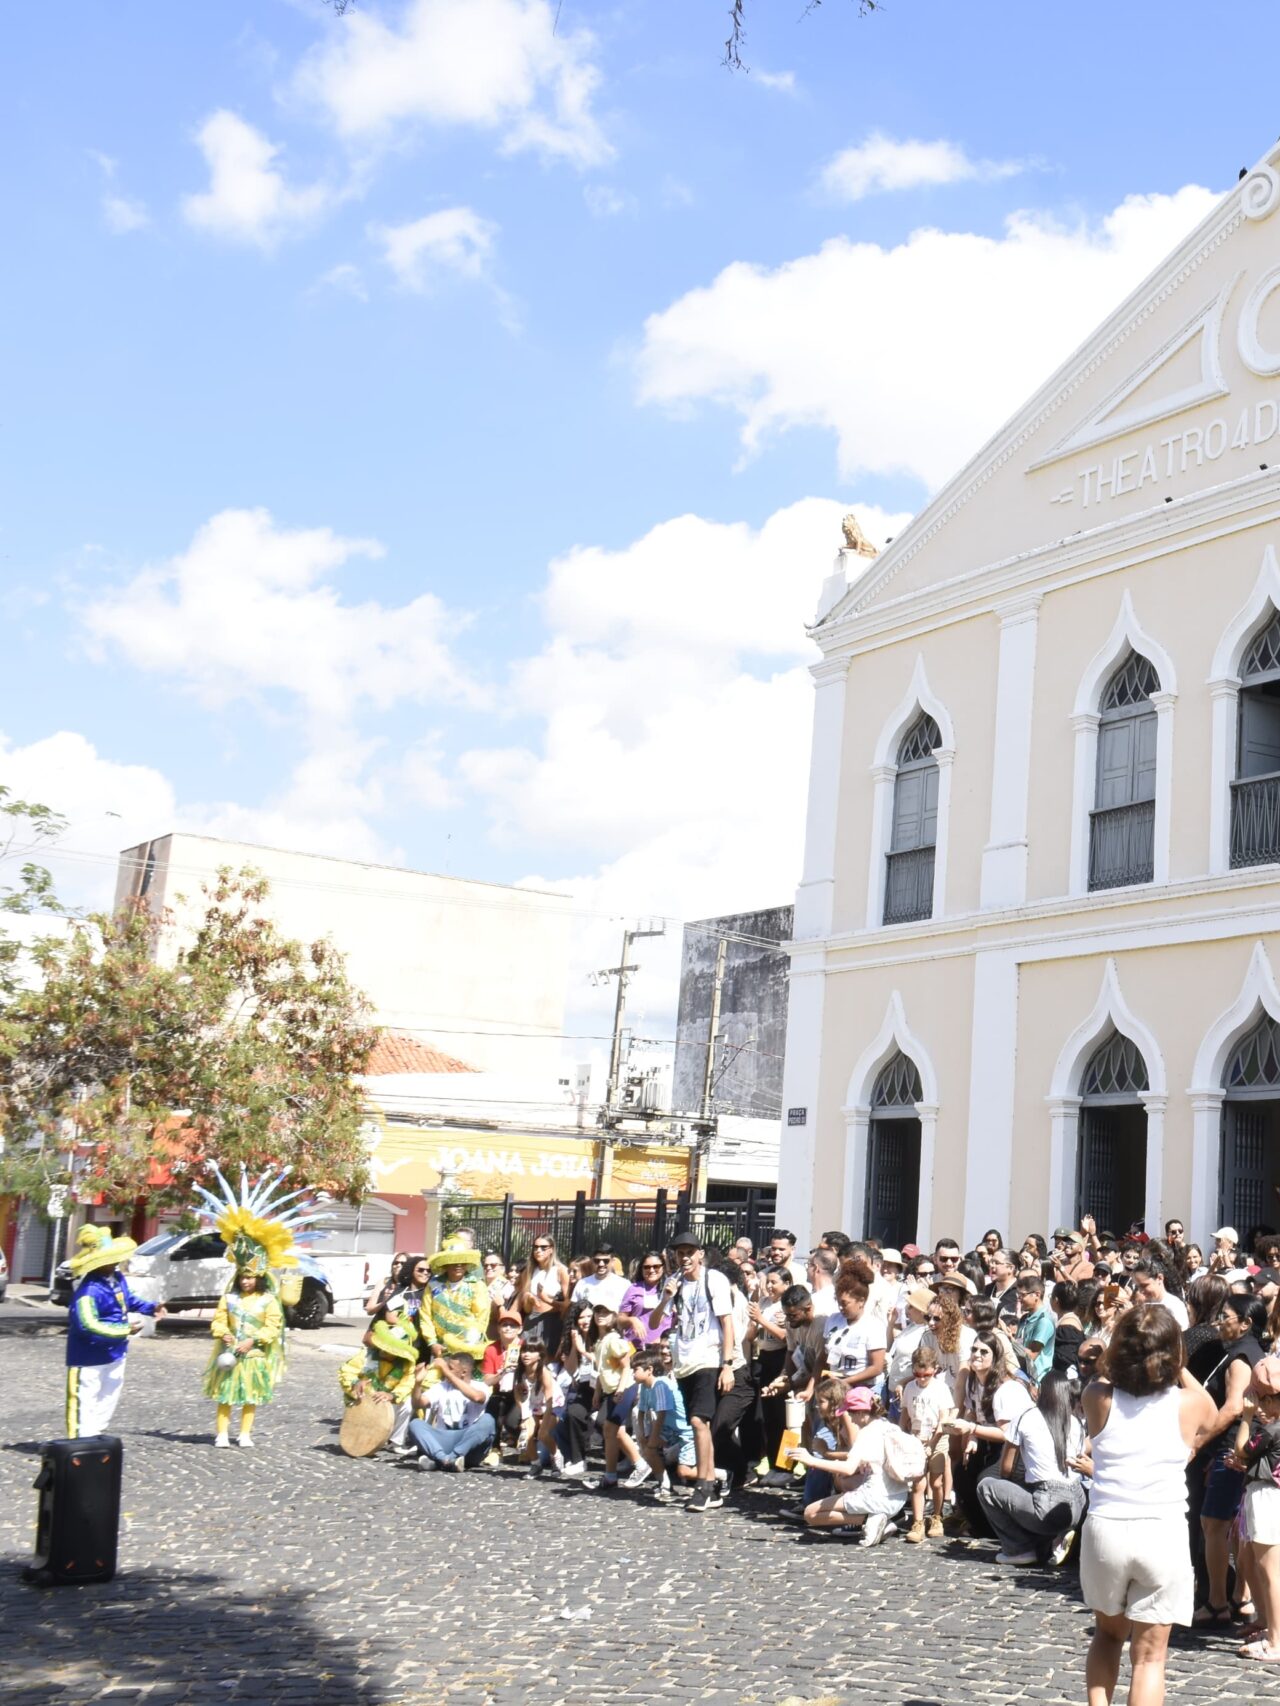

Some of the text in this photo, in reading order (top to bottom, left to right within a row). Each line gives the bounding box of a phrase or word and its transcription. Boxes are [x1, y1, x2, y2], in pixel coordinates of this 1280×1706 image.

[1079, 418, 1228, 507] THEATRO
[1231, 408, 1250, 450] 4
[428, 1146, 525, 1175] JOANA
